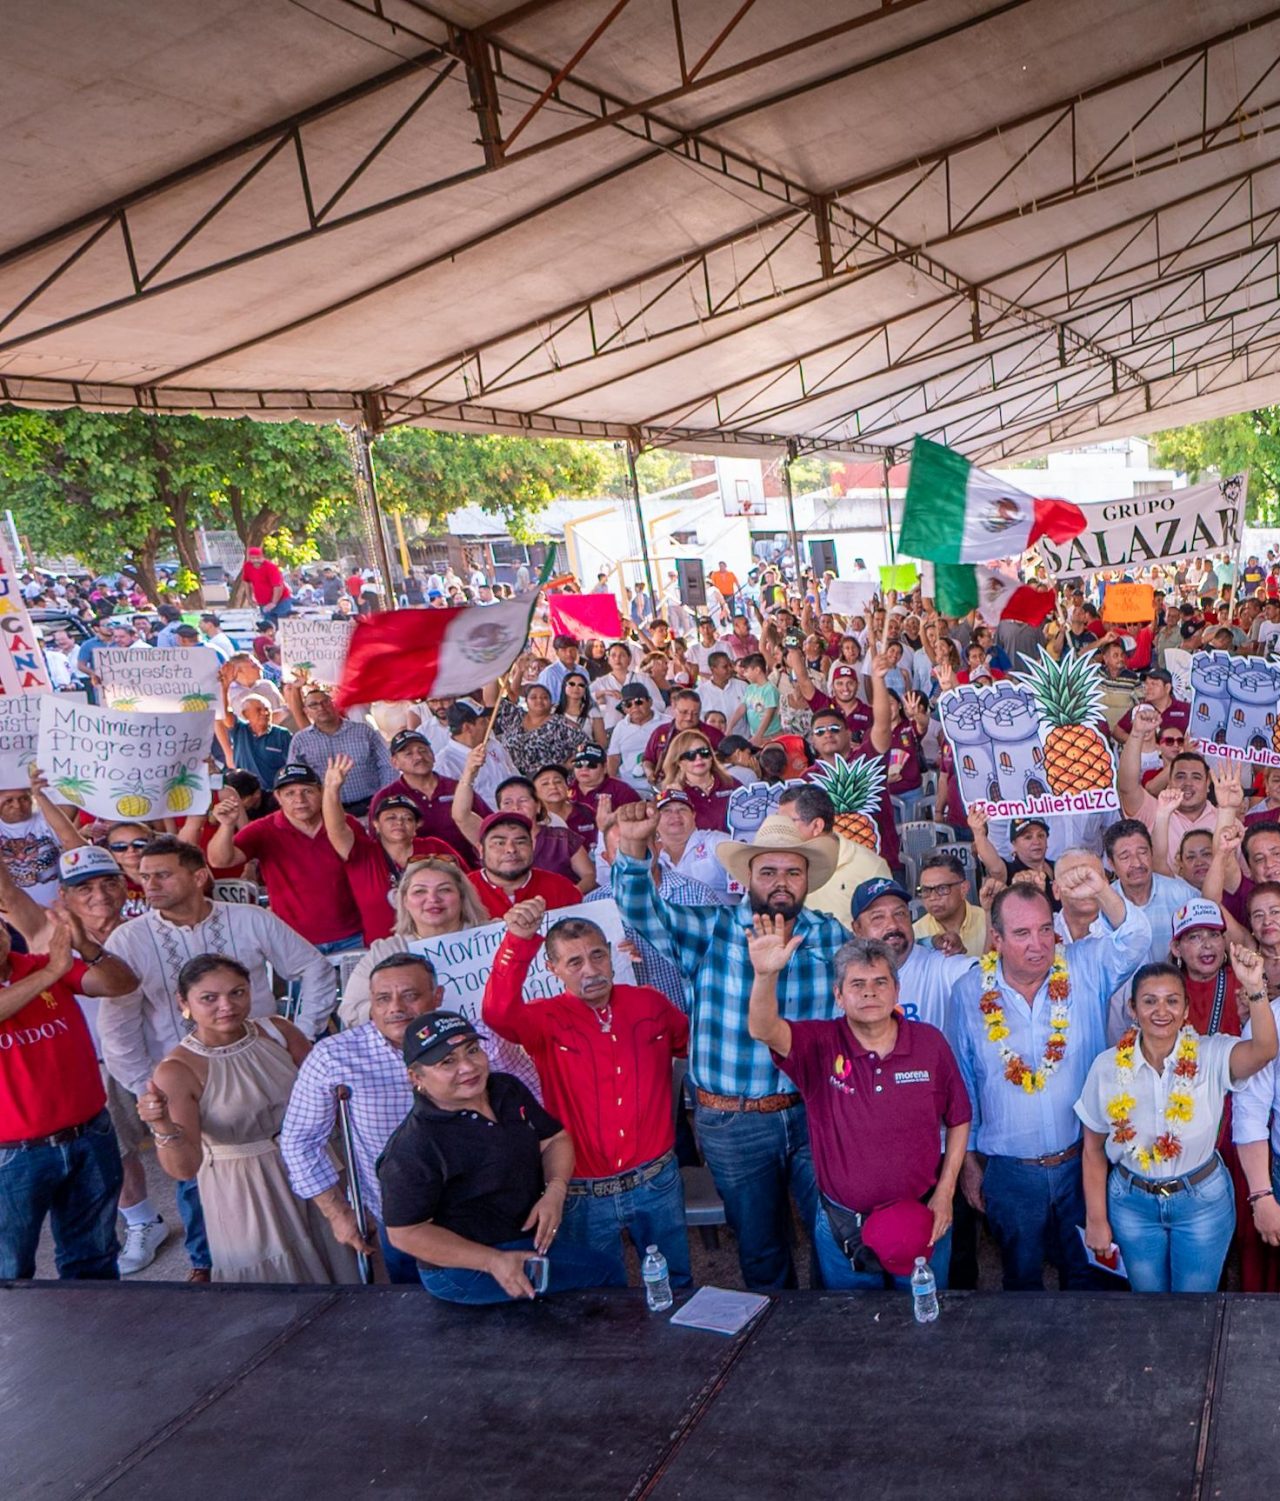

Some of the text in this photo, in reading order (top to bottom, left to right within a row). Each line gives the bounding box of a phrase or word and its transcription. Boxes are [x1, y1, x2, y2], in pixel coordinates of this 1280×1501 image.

[1102, 498, 1175, 521] GRUPO
[53, 706, 177, 739] Movimiento
[47, 727, 203, 762] Progresista
[52, 755, 199, 782] Michoacano
[968, 789, 1118, 818] TeamJulietaLZC
[0, 1018, 69, 1050] ONDON
[894, 1069, 930, 1081] morena
